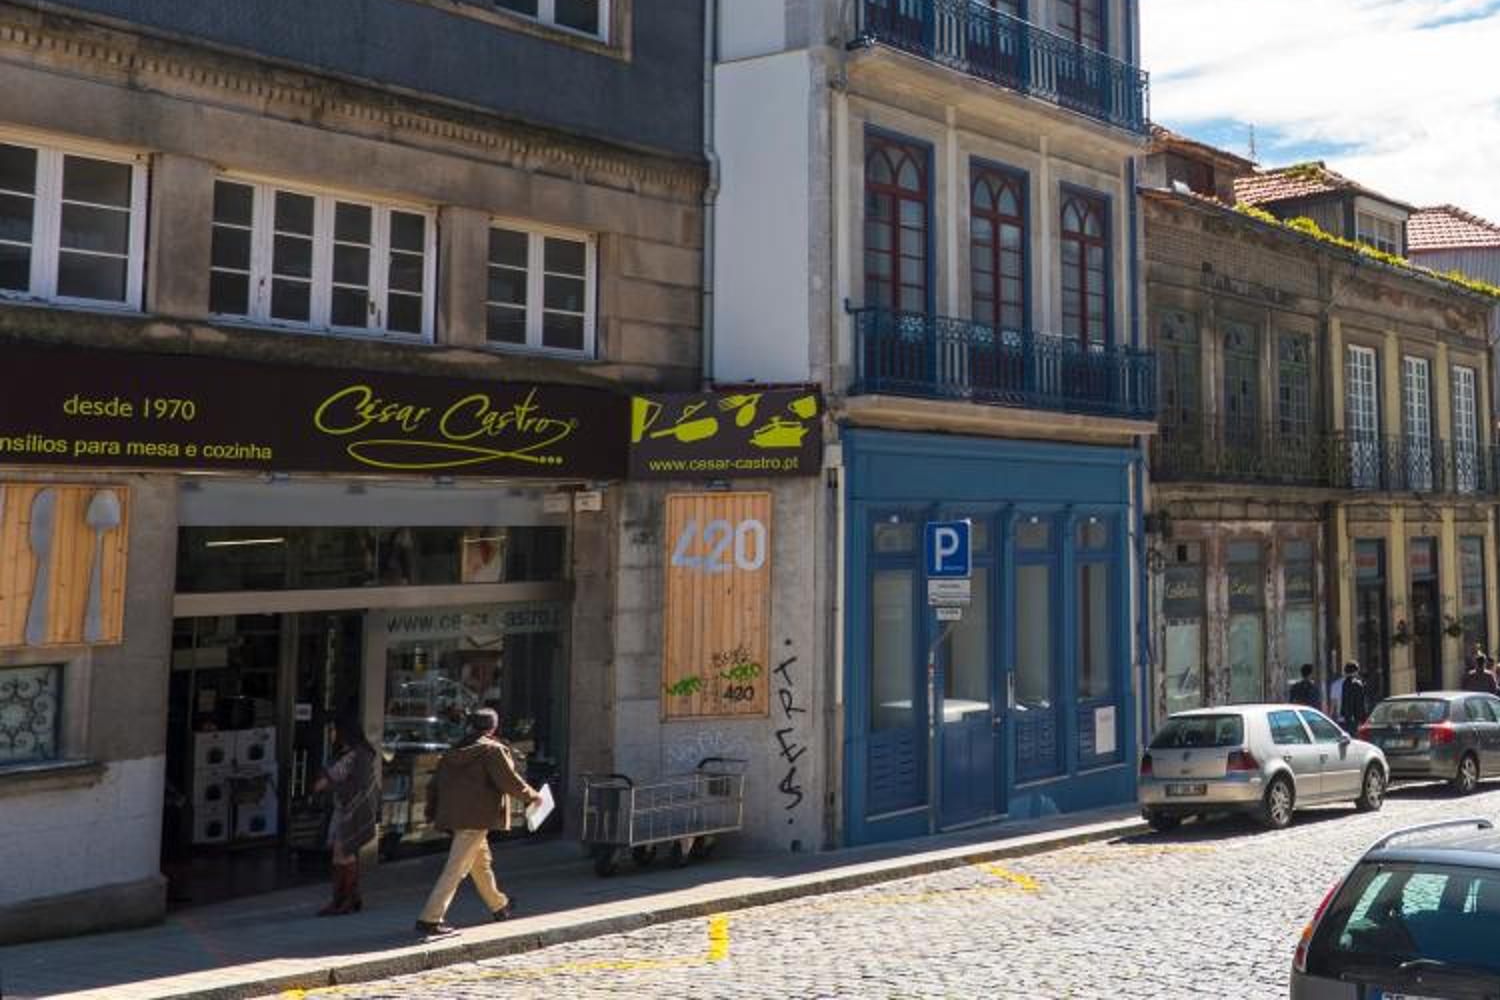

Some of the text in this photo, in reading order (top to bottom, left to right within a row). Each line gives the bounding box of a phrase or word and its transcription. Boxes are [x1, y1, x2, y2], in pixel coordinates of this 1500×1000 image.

[63, 395, 196, 421] desde 1970
[73, 440, 121, 457] para
[126, 443, 180, 458] mesa
[185, 446, 197, 457] e
[202, 443, 273, 460] cozinha
[649, 456, 800, 472] www.cesar-castro.pt
[671, 518, 767, 571] 420
[935, 527, 960, 571] P
